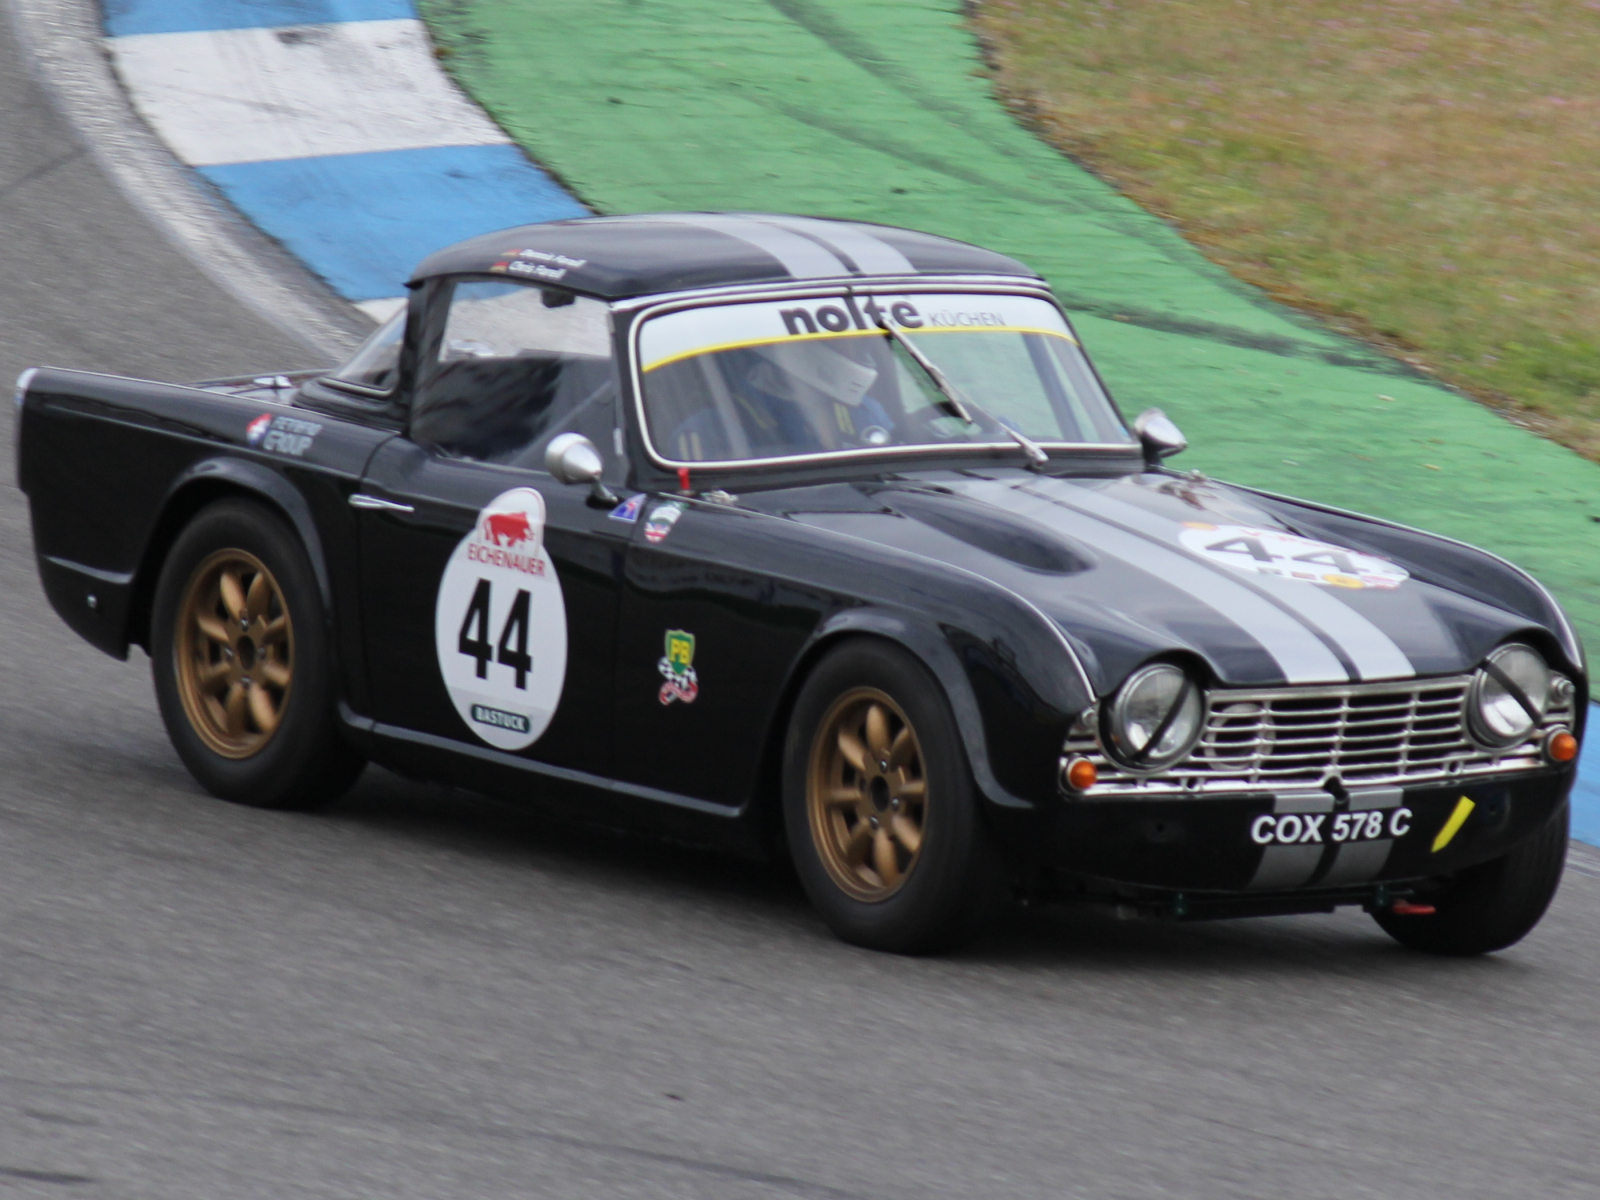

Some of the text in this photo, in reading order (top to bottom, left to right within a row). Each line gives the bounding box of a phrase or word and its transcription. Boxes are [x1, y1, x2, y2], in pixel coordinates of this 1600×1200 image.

[778, 294, 1007, 336] nolte KÜCHEN
[467, 542, 546, 578] EICHENAUER
[1205, 535, 1372, 575] 44
[458, 576, 533, 691] 44
[474, 706, 526, 732] BASTUCK
[1251, 798, 1413, 844] COX 578 C
